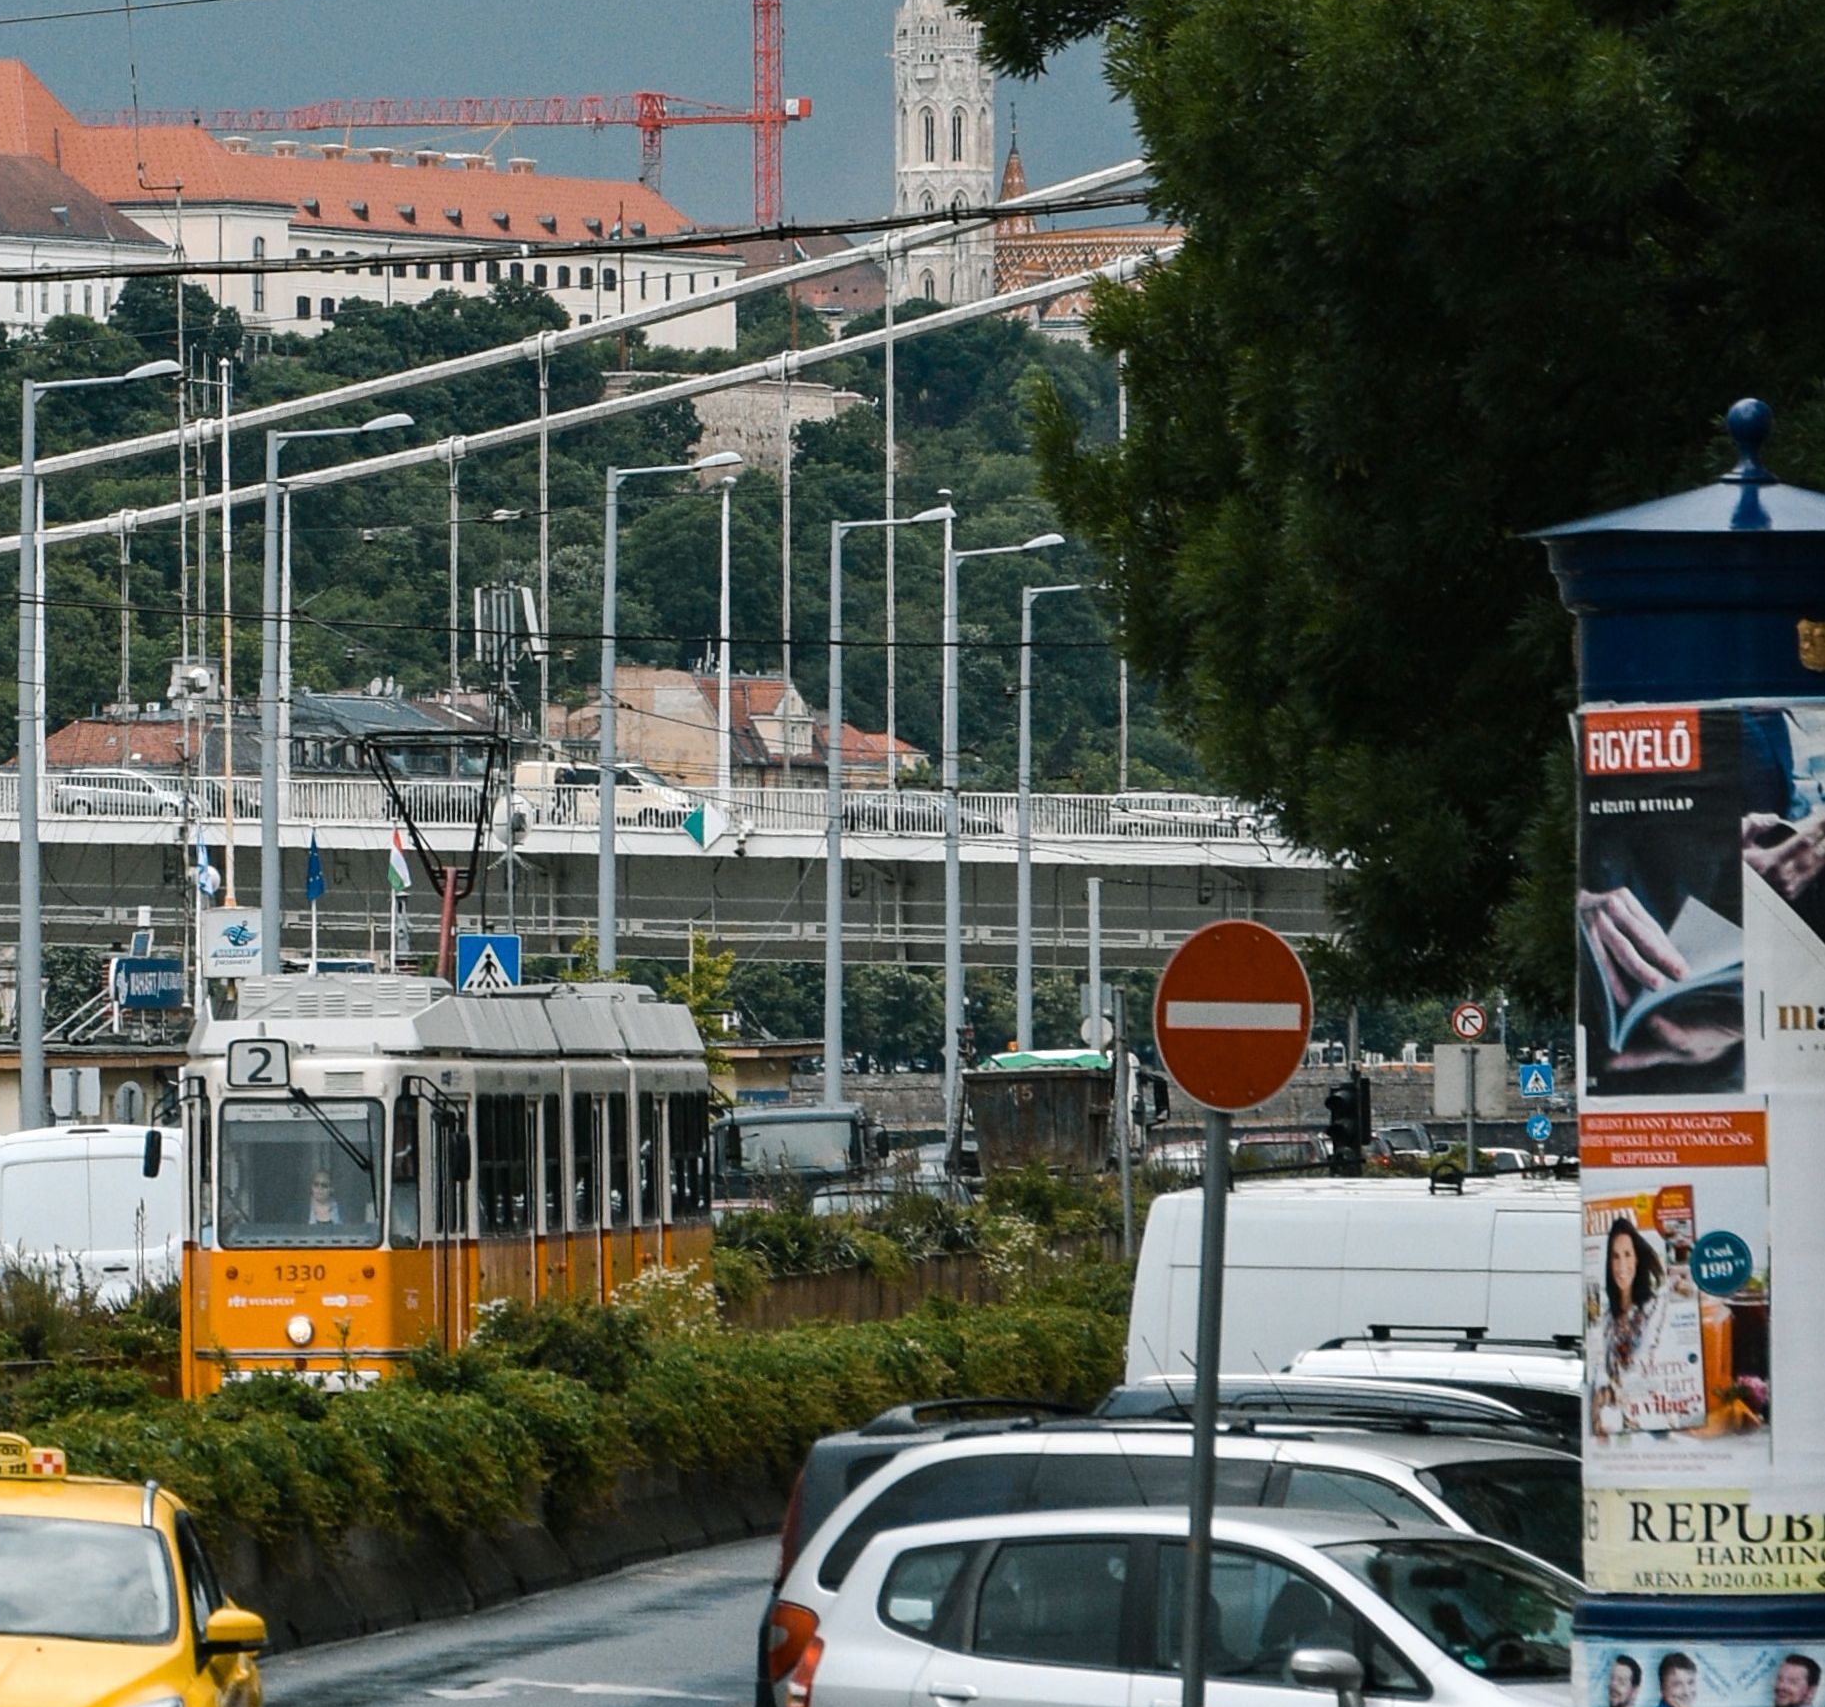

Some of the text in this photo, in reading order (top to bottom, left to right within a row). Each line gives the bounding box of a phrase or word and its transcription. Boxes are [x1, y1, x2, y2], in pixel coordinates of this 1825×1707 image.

[1588, 720, 1691, 771] FIGYELŐ
[1639, 797, 1694, 812] HETILAP
[247, 1046, 273, 1083] 2
[1670, 1116, 1733, 1130] MAGAZIN
[274, 1264, 326, 1282] 1330
[1700, 1262, 1734, 1280] 199
[1631, 1567, 1809, 1588] ARÉNA 2020.03.14.
